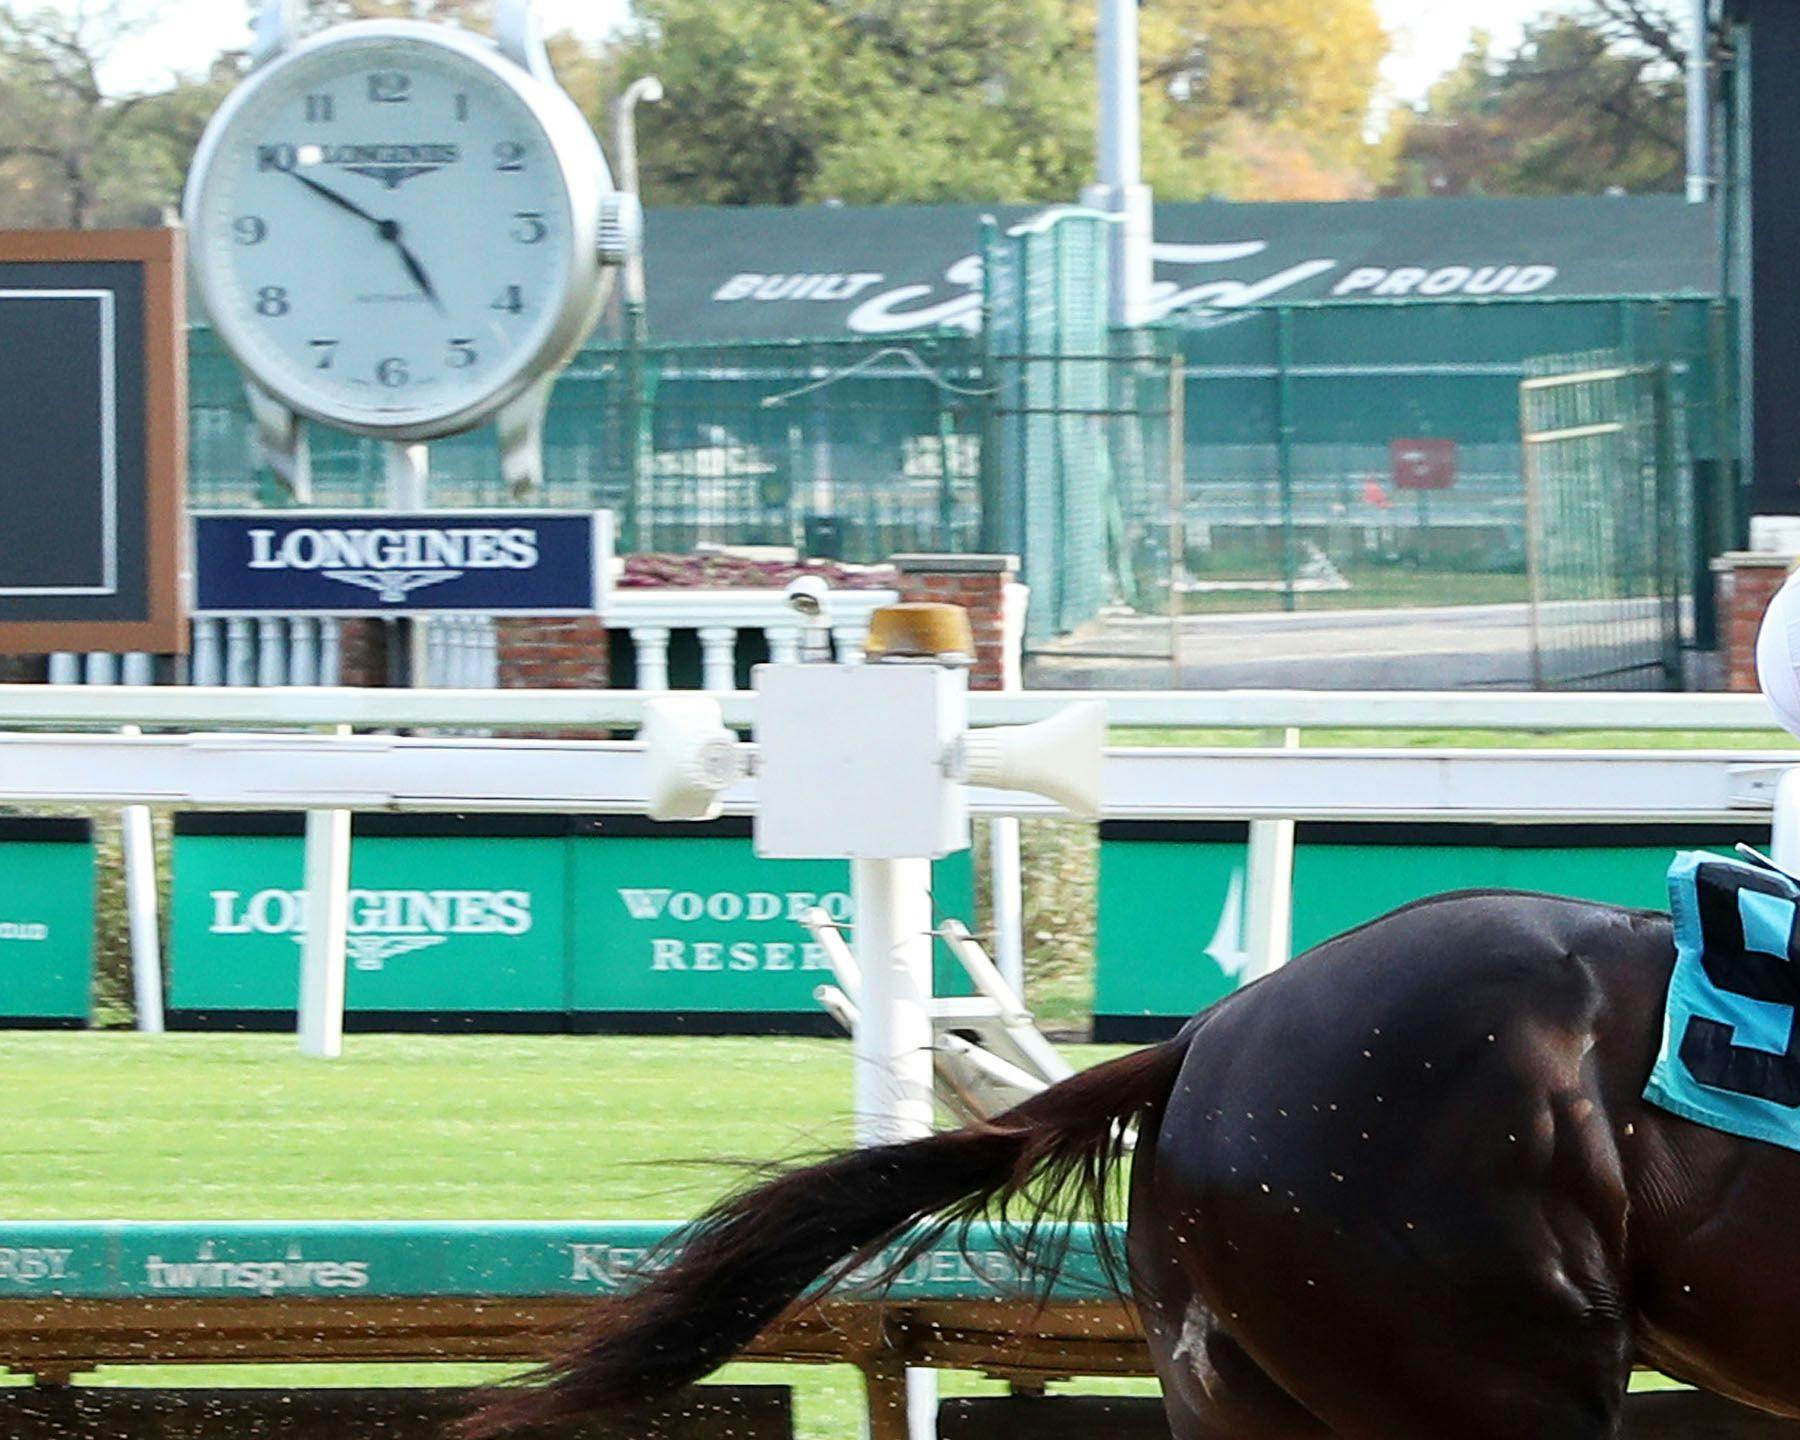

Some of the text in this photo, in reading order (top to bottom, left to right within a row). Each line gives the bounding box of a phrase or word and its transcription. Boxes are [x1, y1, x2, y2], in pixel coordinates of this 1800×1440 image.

[367, 72, 410, 101] 12
[305, 95, 334, 123] 11
[493, 142, 527, 171] 2
[233, 217, 267, 246] 9
[511, 212, 547, 244] 3
[714, 273, 885, 301] BUILT
[1332, 265, 1558, 296] PROUD
[256, 286, 290, 317] 8
[491, 285, 524, 314] 4
[309, 339, 339, 369] 7
[447, 338, 477, 368] 5
[376, 357, 409, 388] 6
[247, 528, 539, 569] LONGINES
[617, 888, 853, 921] WOODFO
[650, 938, 834, 971] RESER
[146, 1241, 369, 1296] twinspires
